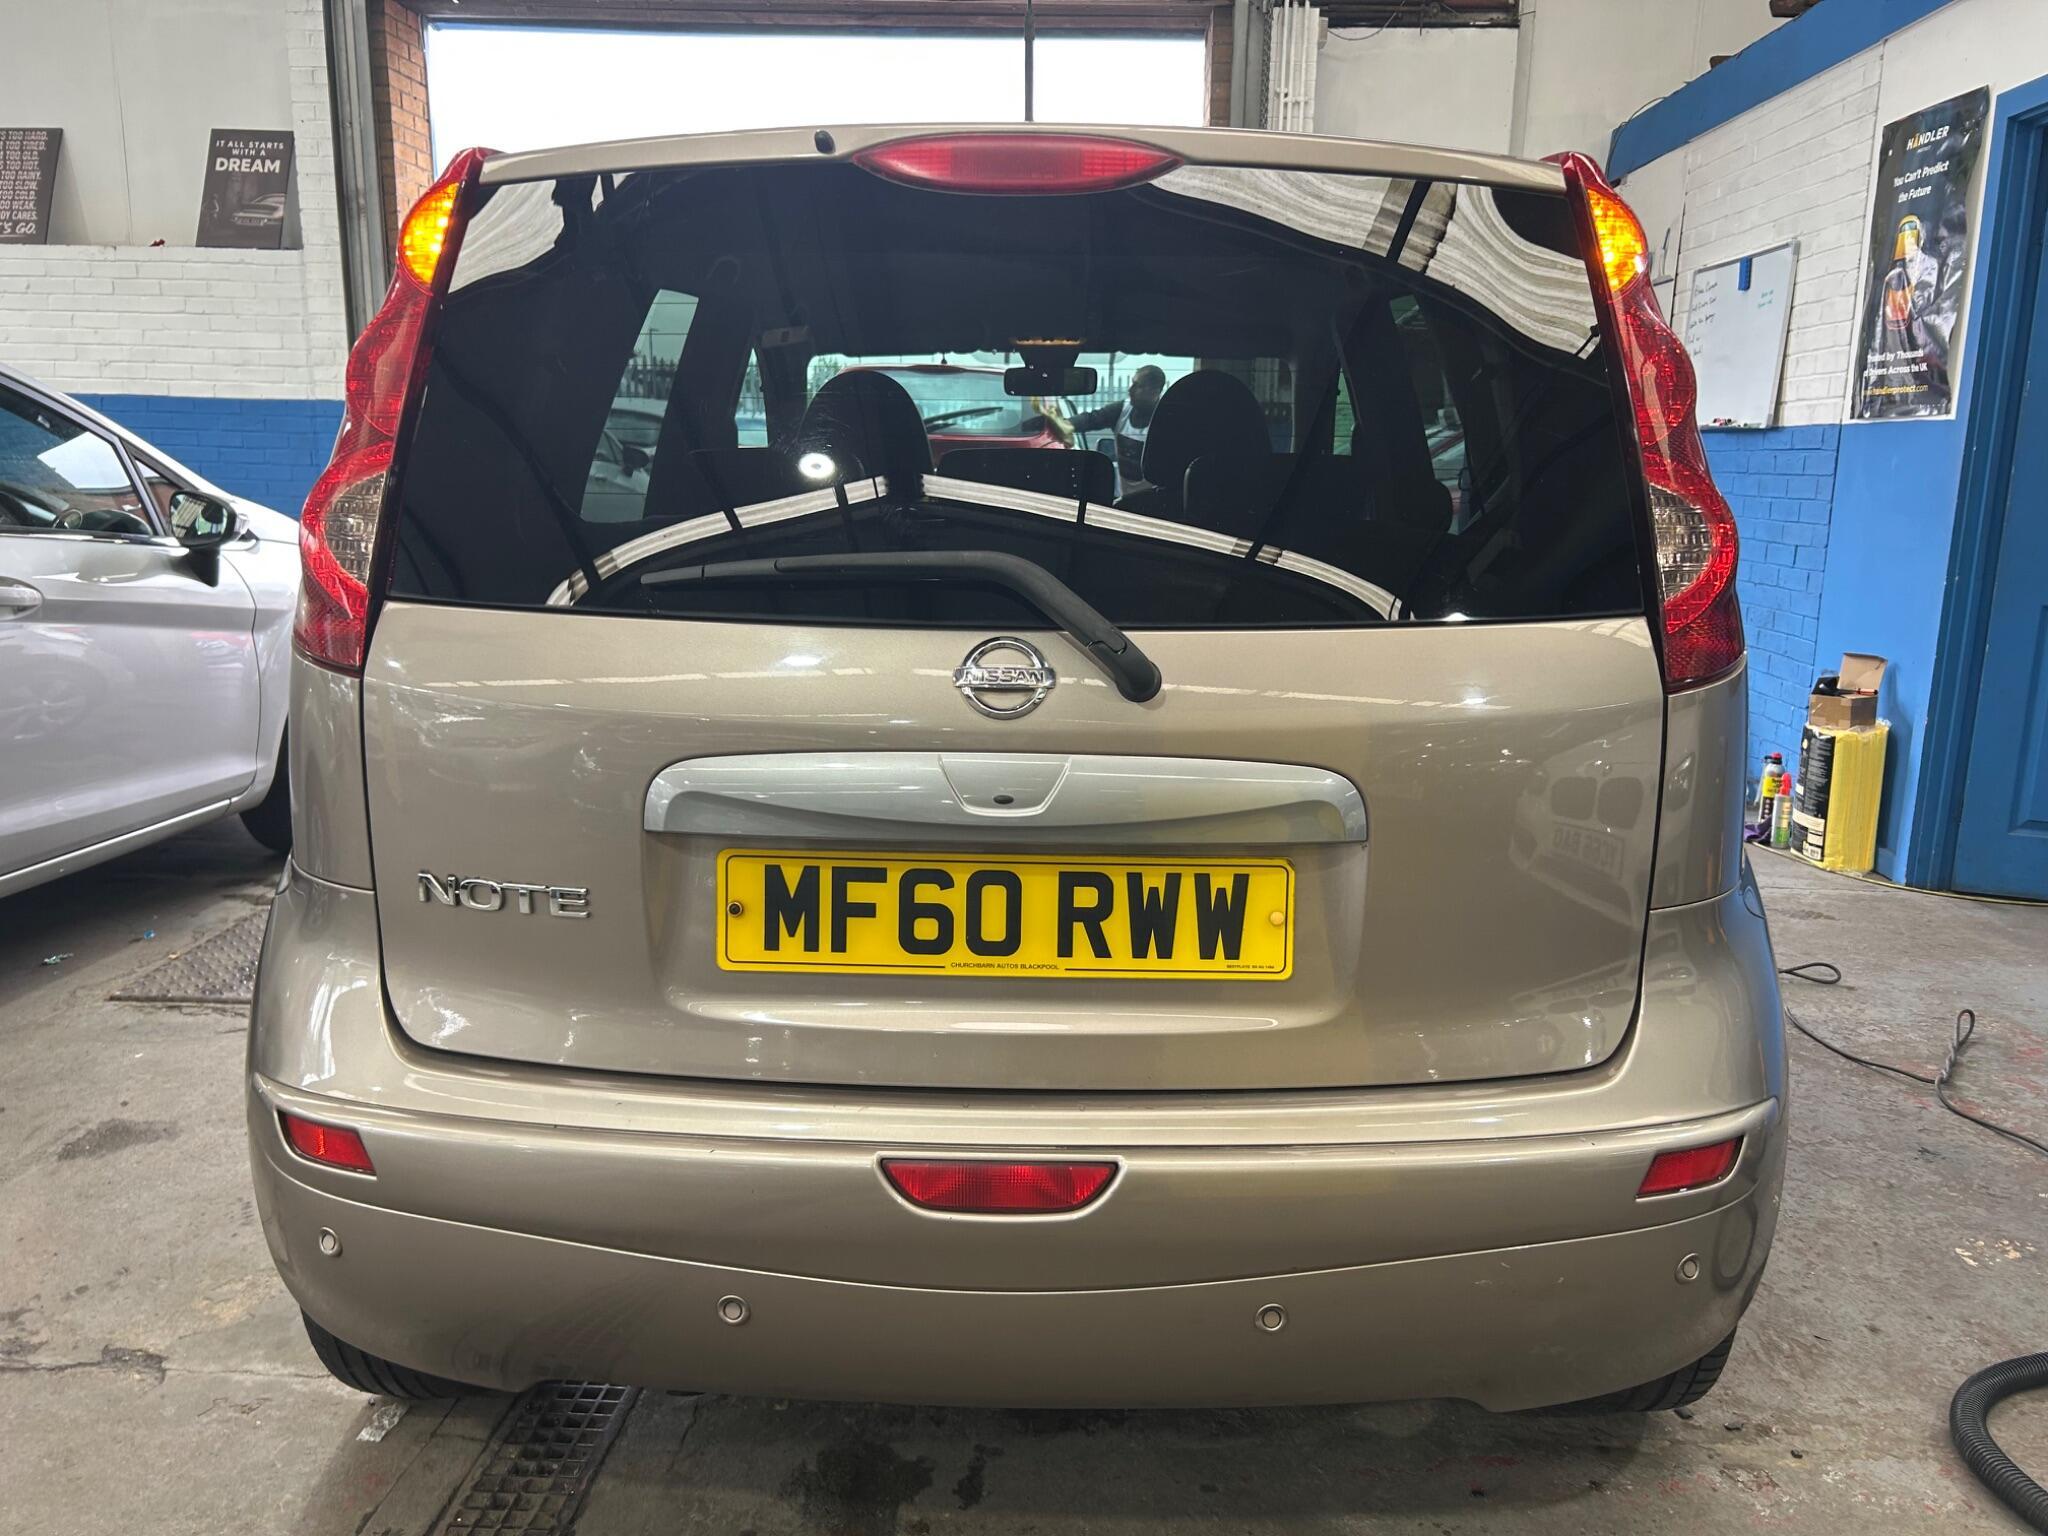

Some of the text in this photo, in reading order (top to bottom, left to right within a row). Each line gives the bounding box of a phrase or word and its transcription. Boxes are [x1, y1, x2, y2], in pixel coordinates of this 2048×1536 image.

[248, 142, 284, 150] STARTS
[1906, 126, 1950, 151] HANDLER
[232, 148, 256, 156] WITH
[215, 157, 281, 174] DREAM
[1921, 160, 1950, 178] Predict
[1908, 185, 1932, 200] Future
[1886, 351, 1896, 362] by
[1888, 365, 1911, 375] Across
[1919, 362, 1928, 371] UK
[963, 667, 1047, 685] NISSAN
[417, 872, 591, 919] NOTE
[764, 864, 1250, 961] MF60 RWW
